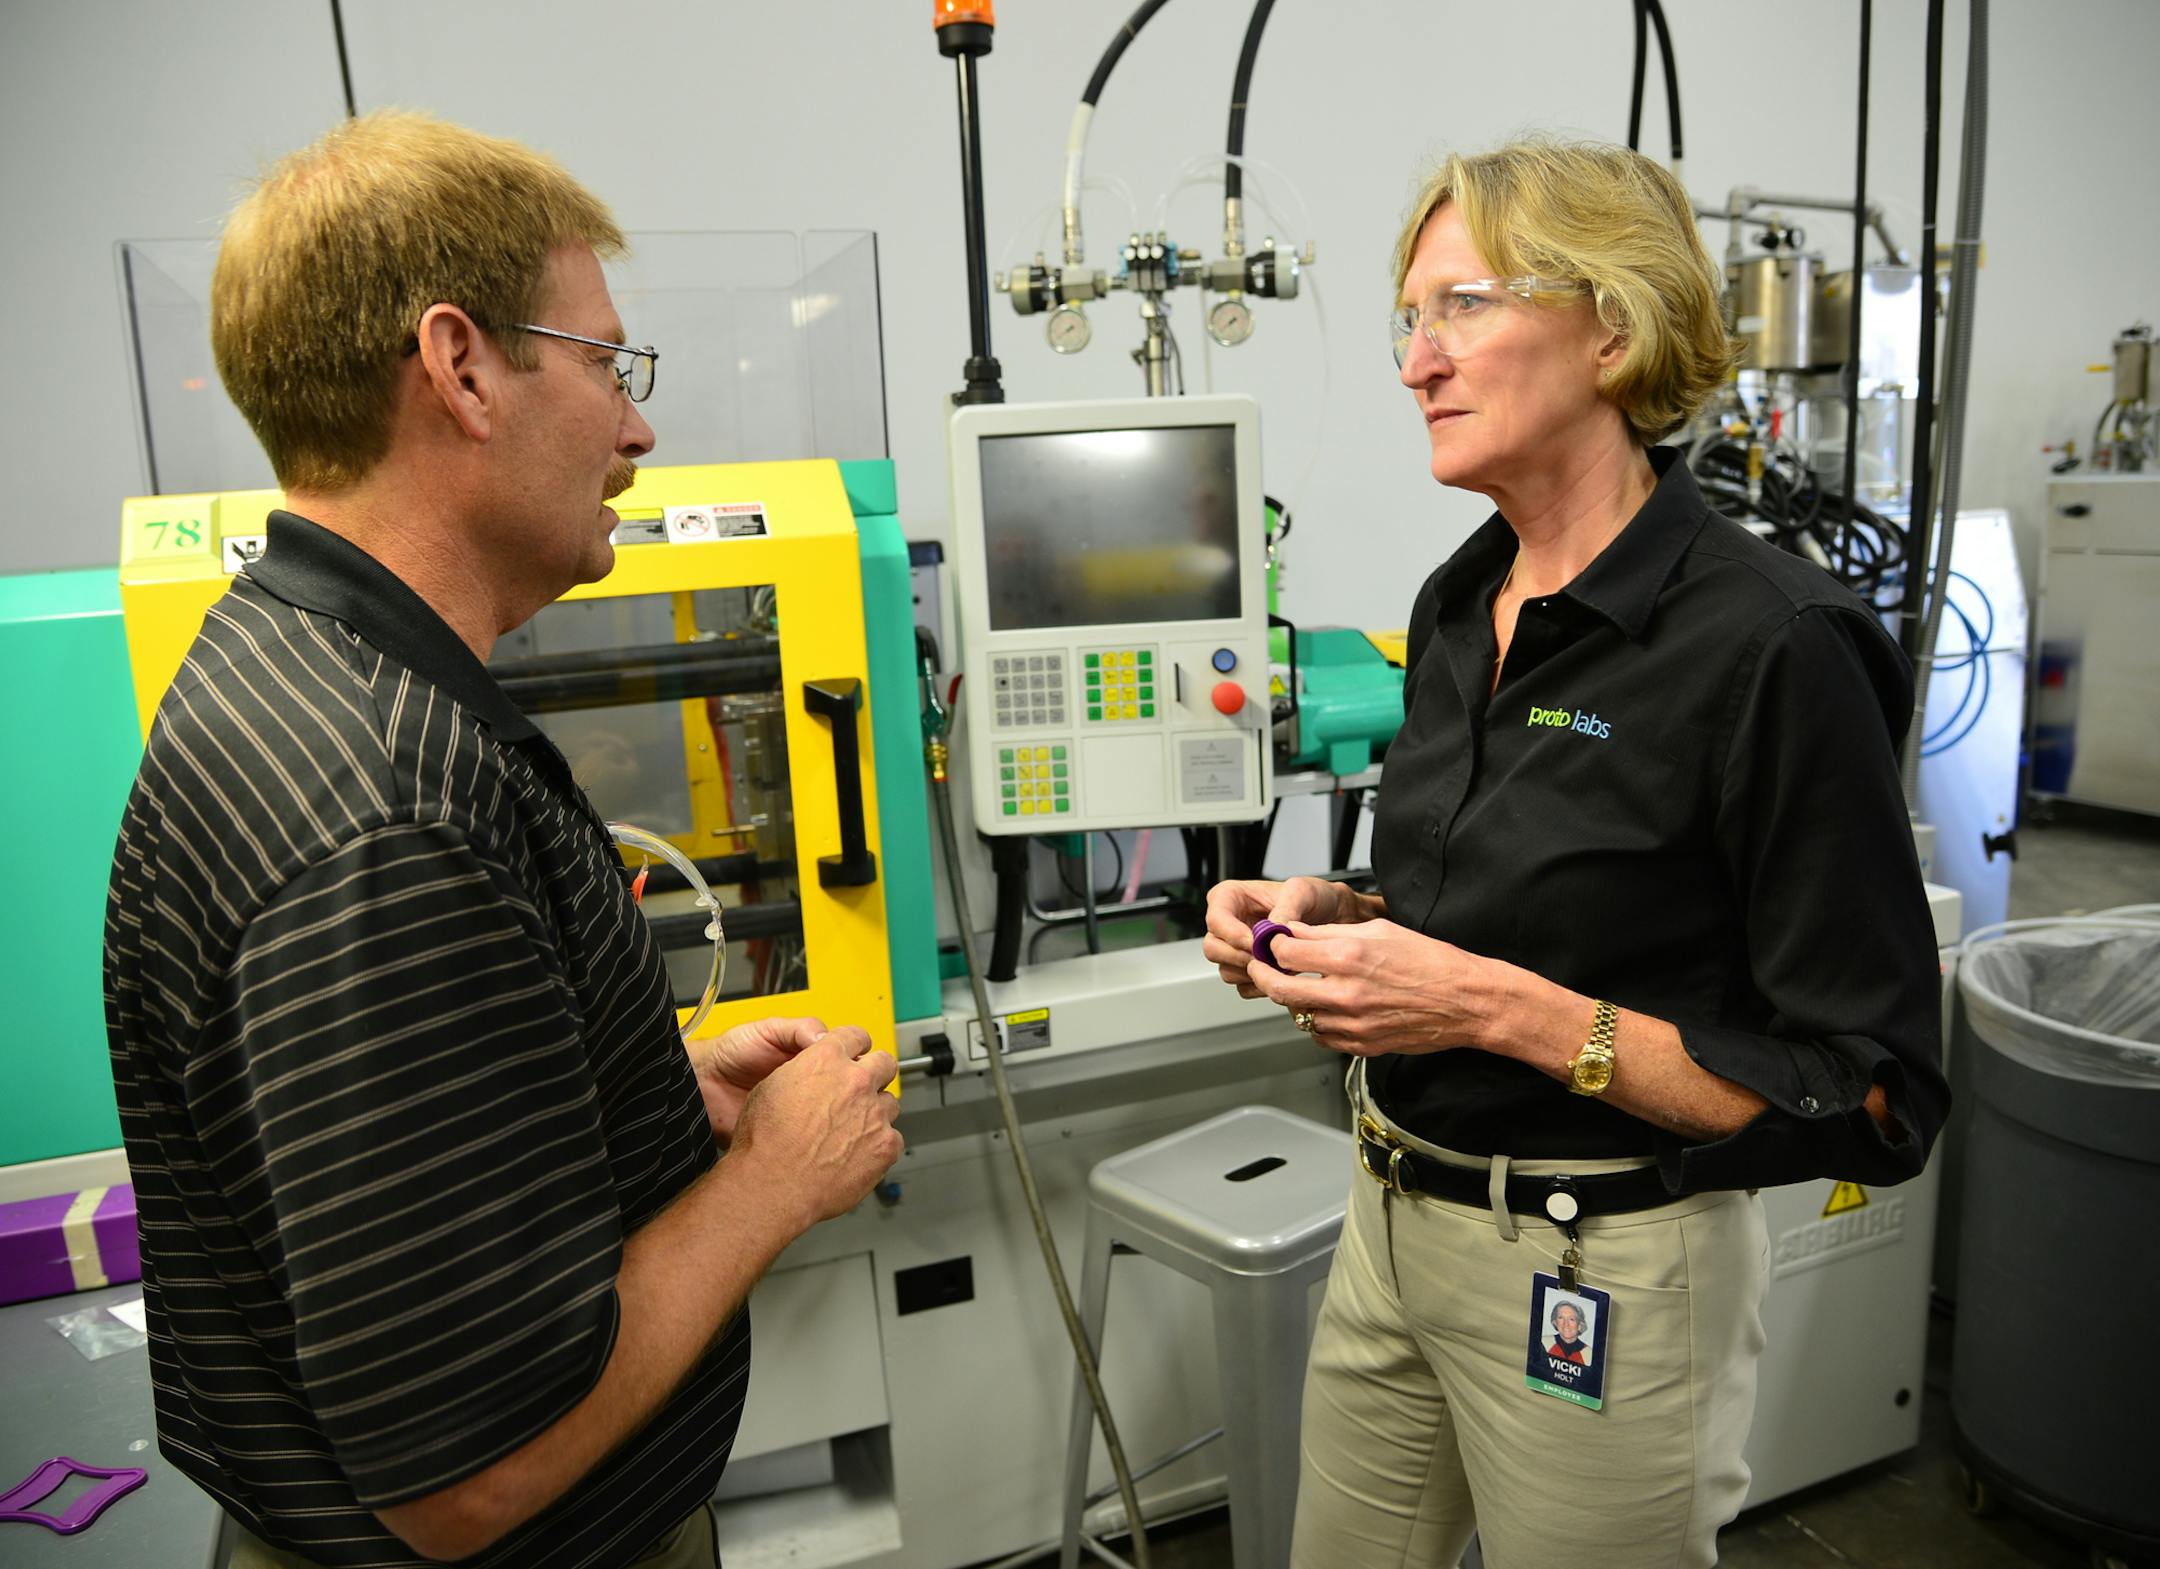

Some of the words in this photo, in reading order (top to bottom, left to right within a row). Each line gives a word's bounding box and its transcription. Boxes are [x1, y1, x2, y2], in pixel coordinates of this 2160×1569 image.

[144, 519, 201, 550] 78
[1527, 706, 1571, 727] proto
[1570, 709, 1612, 739] labs
[1548, 1357, 1582, 1377] VICKI
[1554, 1372, 1574, 1383] HOLT
[1543, 1383, 1581, 1401] EMPLOYEE
